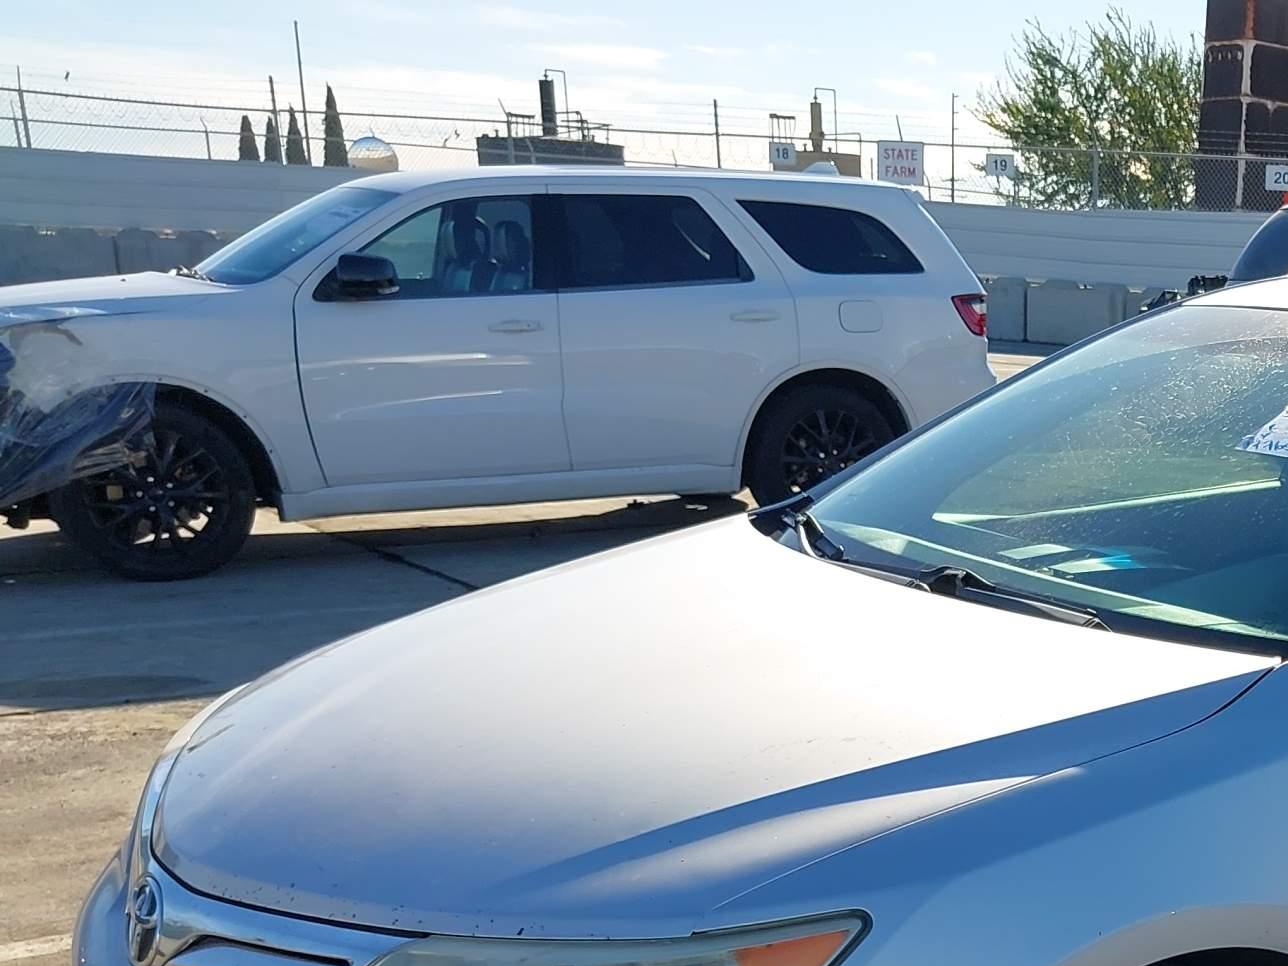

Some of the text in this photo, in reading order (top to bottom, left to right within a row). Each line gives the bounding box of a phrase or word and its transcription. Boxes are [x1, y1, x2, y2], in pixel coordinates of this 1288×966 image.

[775, 147, 789, 160] 18
[883, 148, 918, 162] STATE
[884, 165, 918, 179] FARM
[993, 159, 1008, 172] 19
